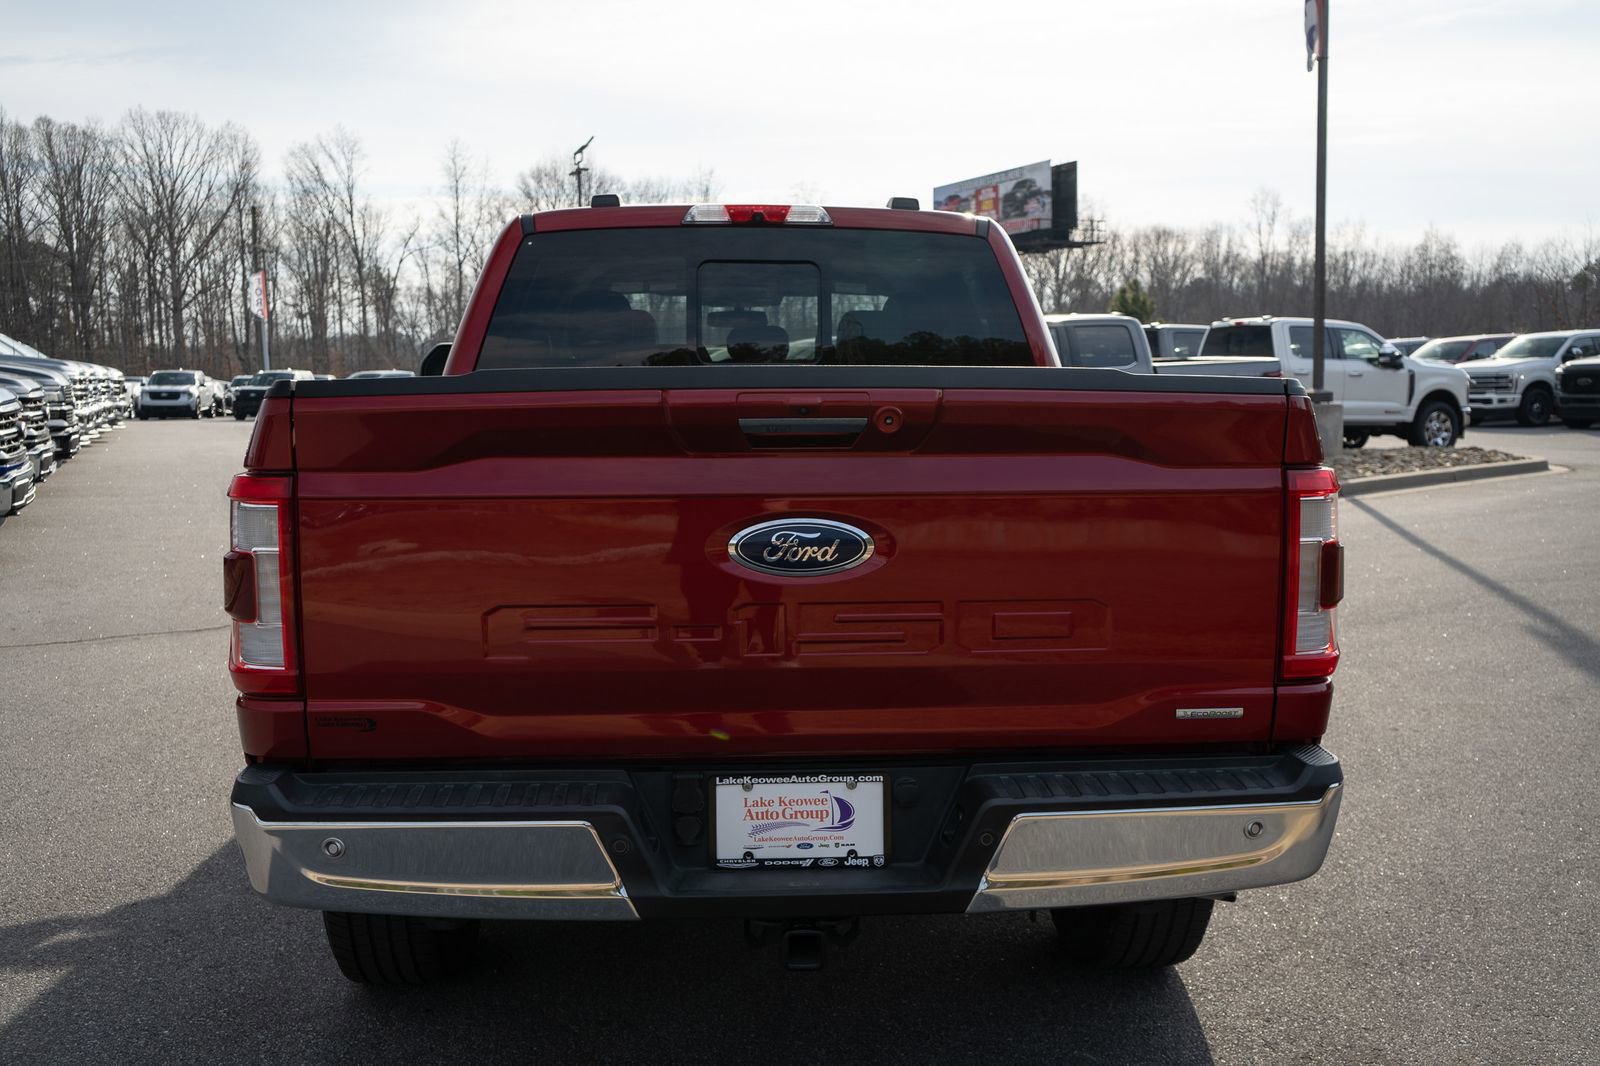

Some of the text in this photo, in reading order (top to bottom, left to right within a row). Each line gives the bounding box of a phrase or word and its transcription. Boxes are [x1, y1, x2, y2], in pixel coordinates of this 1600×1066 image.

[763, 531, 840, 562] Ford
[482, 600, 1109, 658] F-150
[716, 775, 883, 784] LakeKeoweeAutoGroup.com
[744, 796, 828, 808] Lake Keowee
[743, 807, 830, 822] Auto Group
[844, 857, 869, 867] Jeep
